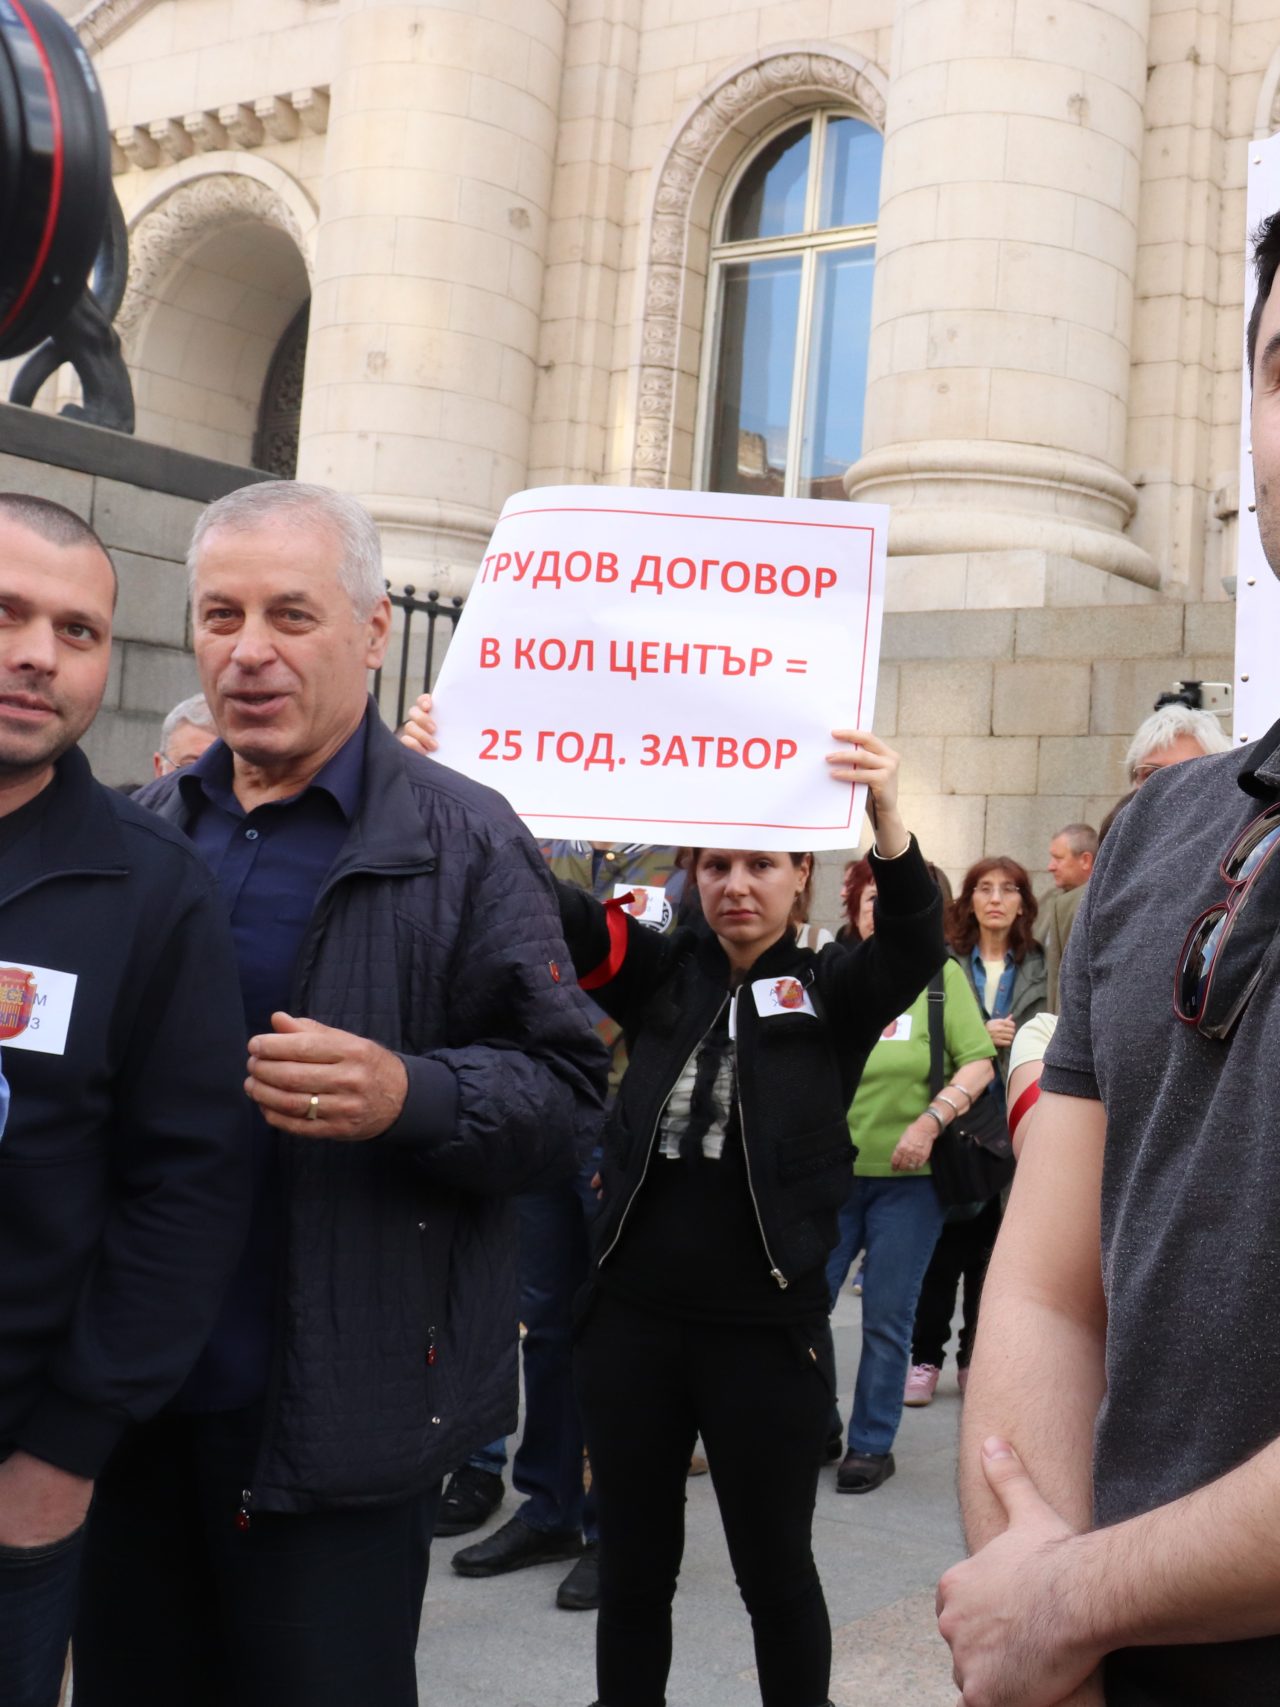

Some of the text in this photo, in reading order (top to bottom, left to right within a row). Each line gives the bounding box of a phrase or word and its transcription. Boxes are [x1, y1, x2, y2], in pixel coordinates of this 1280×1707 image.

[482, 550, 838, 599] ТРУДОВ ДОГОВОР
[479, 637, 501, 669] В
[514, 637, 595, 672] КОЛ
[609, 639, 773, 681] ЦЕНТЪР
[478, 728, 798, 772] 25 ГОД. ЗАТВОР
